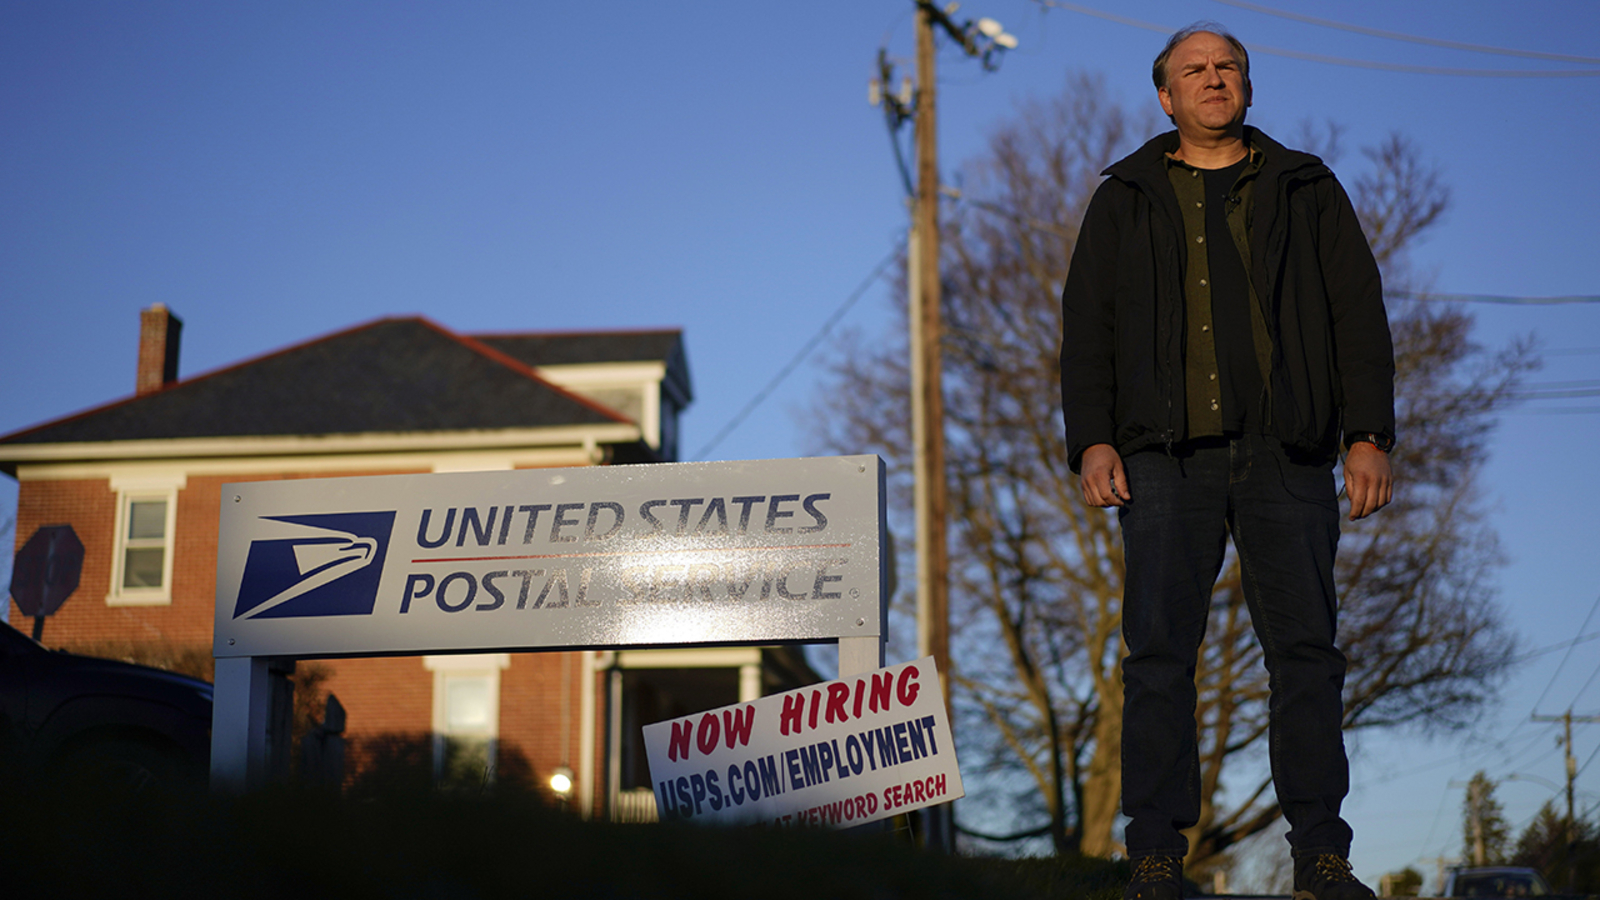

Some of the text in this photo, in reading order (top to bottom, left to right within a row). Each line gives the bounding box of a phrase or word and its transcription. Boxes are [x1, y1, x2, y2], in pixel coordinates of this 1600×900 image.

[416, 493, 831, 549] UNITED STATES
[399, 557, 849, 614] POSTAL SERVICE
[668, 665, 920, 762] NOW HIRING
[659, 715, 939, 820] USPS.COM/EMPLOYMENT
[797, 793, 878, 831] KEYWORD
[883, 773, 947, 810] SEARCH
